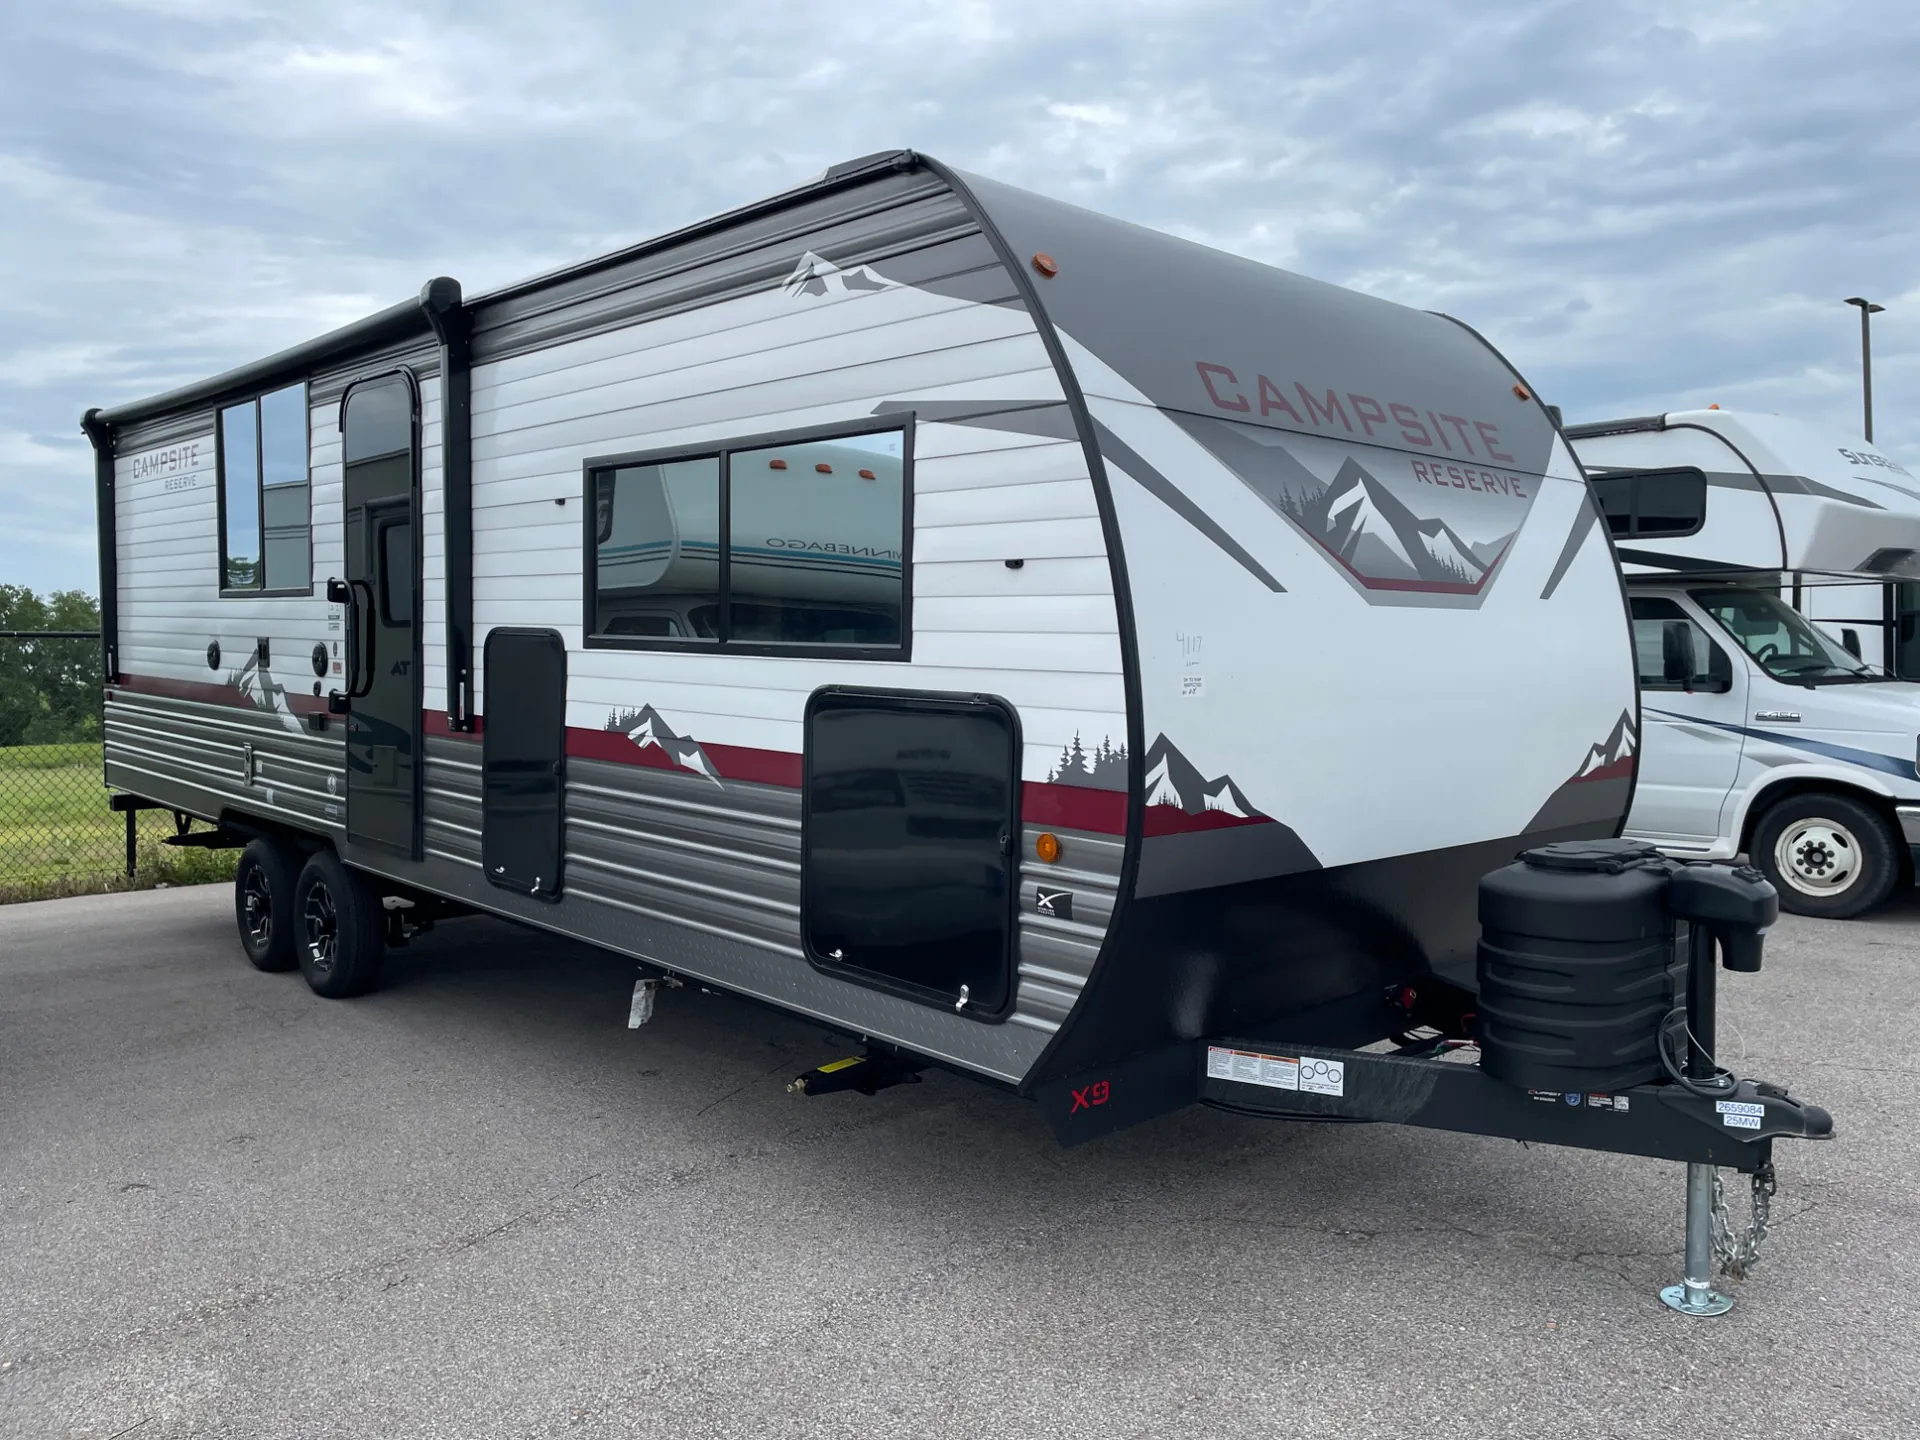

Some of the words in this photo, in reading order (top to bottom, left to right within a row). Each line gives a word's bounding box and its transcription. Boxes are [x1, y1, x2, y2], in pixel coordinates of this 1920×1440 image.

[1196, 361, 1514, 463] CAMPSITE
[133, 444, 199, 479] CAMPSITE
[164, 475, 197, 491] RESERVE
[1410, 459, 1527, 498] RESERVE
[1071, 1081, 1111, 1113] X9
[1718, 1102, 1763, 1115] 2659084
[1726, 1116, 1759, 1127] 25MW
